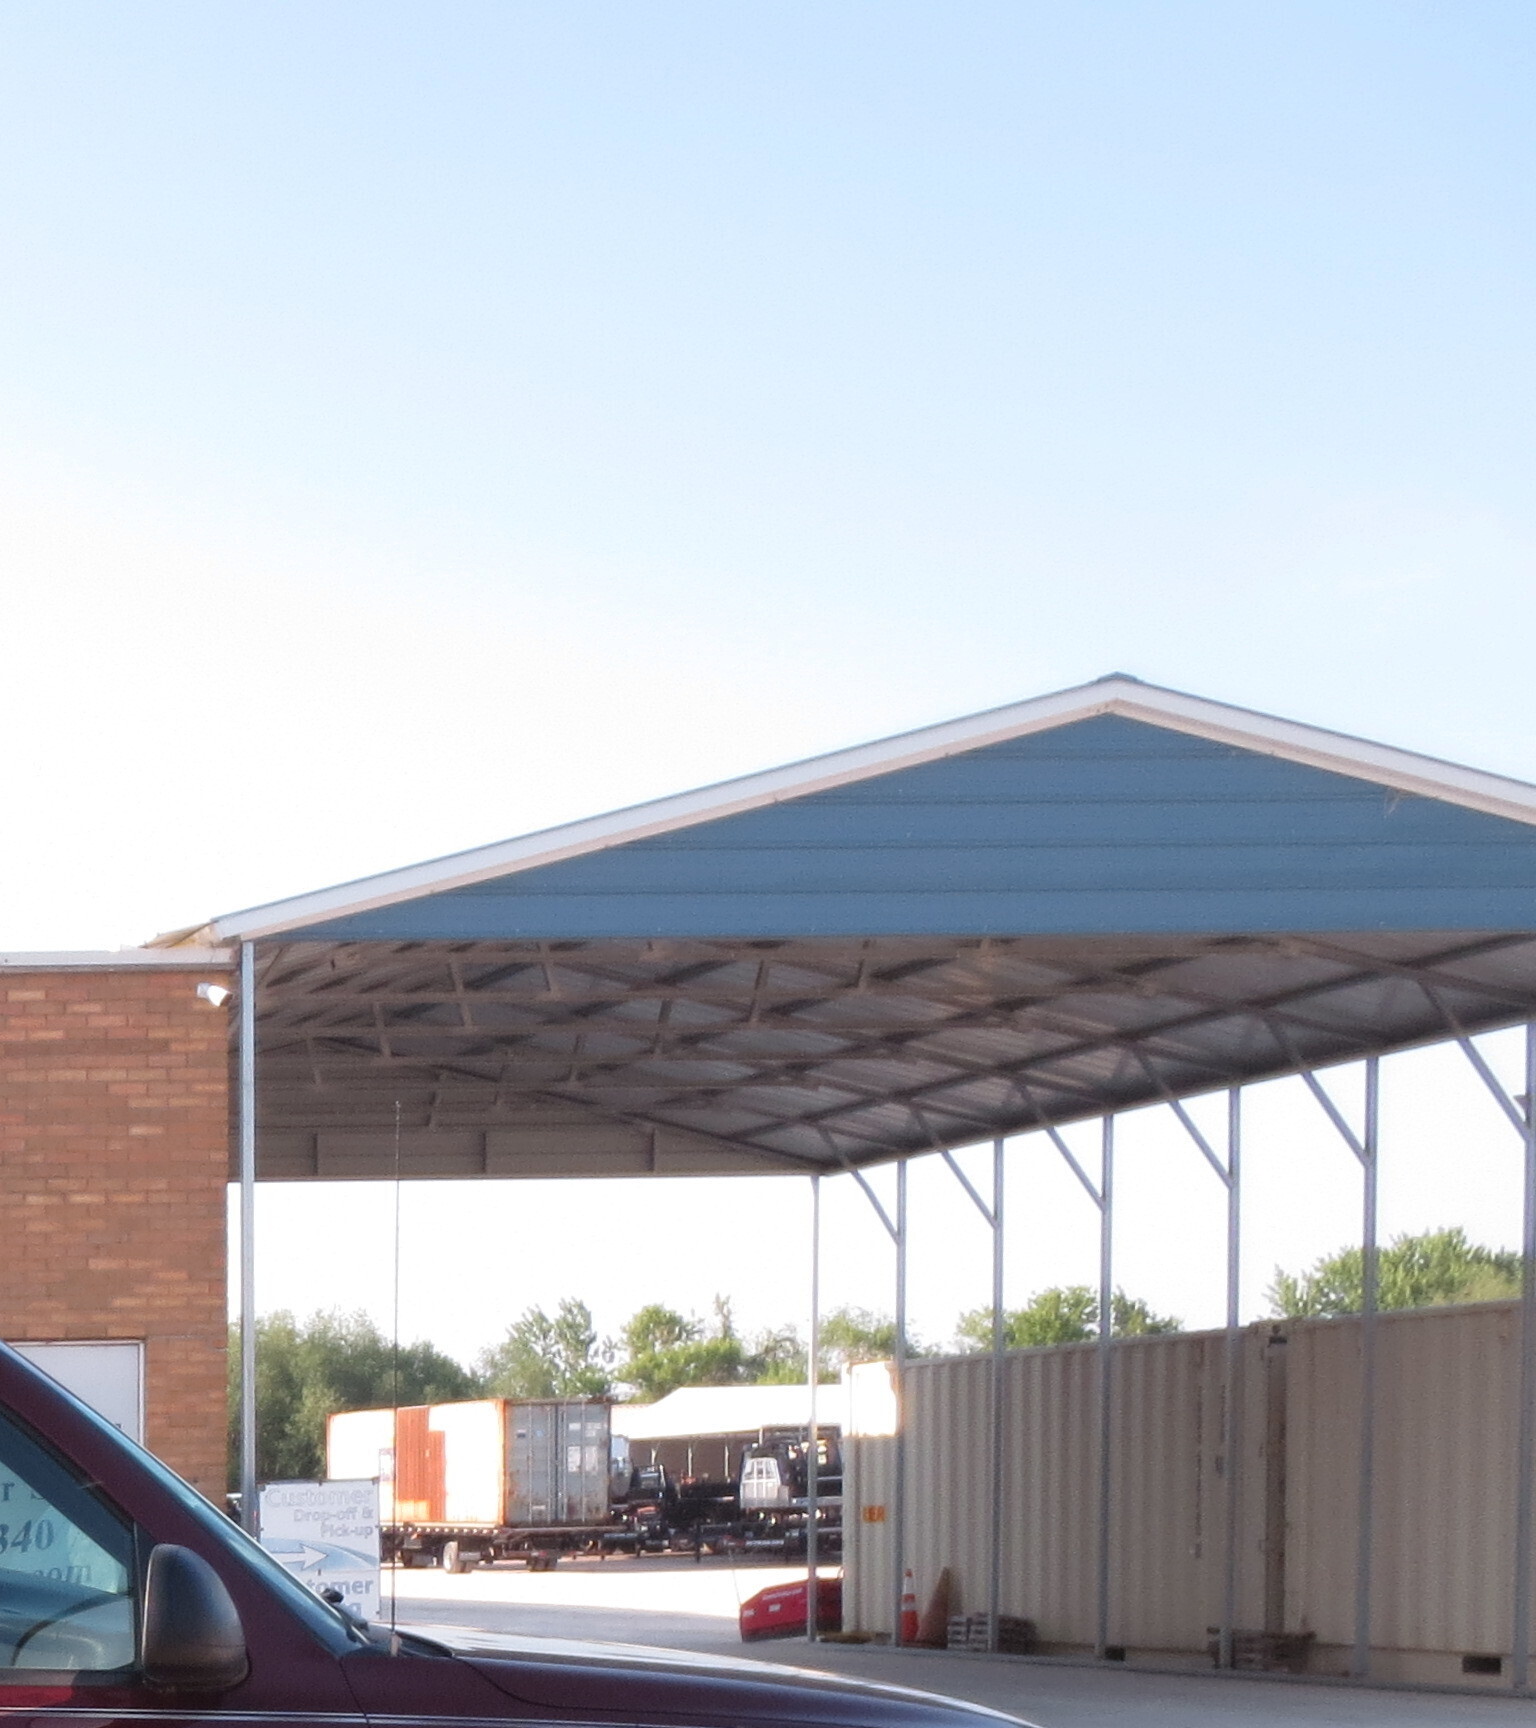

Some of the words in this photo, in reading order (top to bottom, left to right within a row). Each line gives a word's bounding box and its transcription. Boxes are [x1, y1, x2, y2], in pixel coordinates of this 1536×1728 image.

[265, 1488, 374, 1508] Customer
[293, 1506, 358, 1522] Drop-off
[319, 1520, 374, 1540] Pick-up
